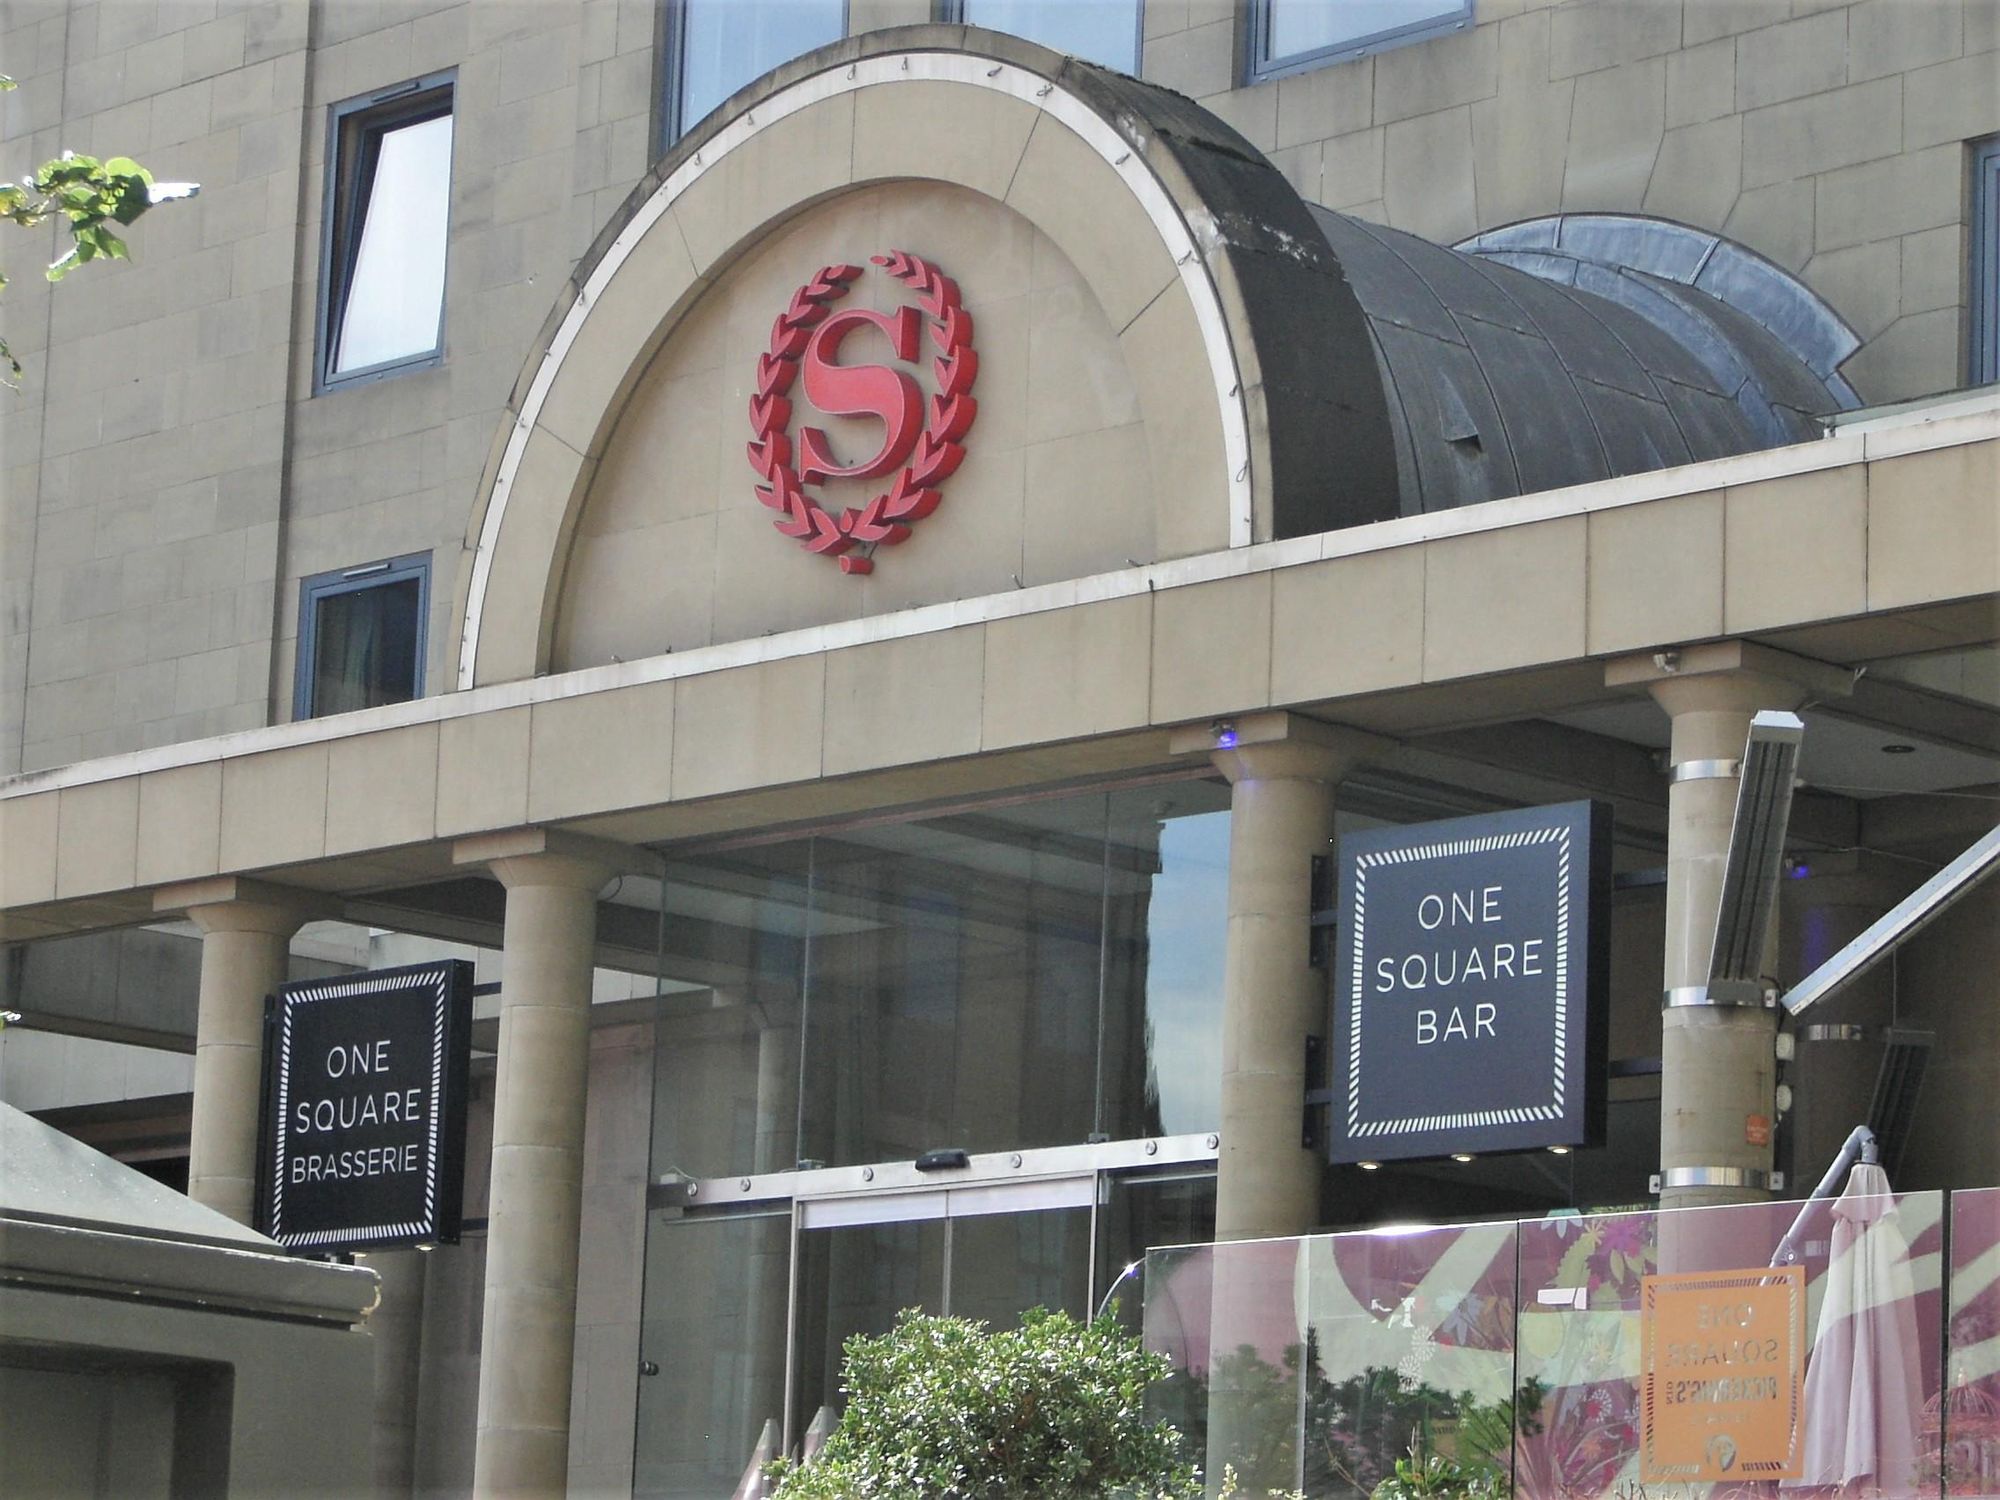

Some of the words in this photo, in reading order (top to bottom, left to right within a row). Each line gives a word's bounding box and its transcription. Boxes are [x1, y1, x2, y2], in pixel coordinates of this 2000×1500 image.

[799, 305, 923, 486] S
[1417, 885, 1503, 930] ONE
[1375, 938, 1543, 993] SQUARE
[1416, 1002, 1497, 1045] BAR
[326, 1039, 392, 1079] ONE
[295, 1088, 422, 1134] SQUARE
[291, 1144, 419, 1184] BRASSERIE
